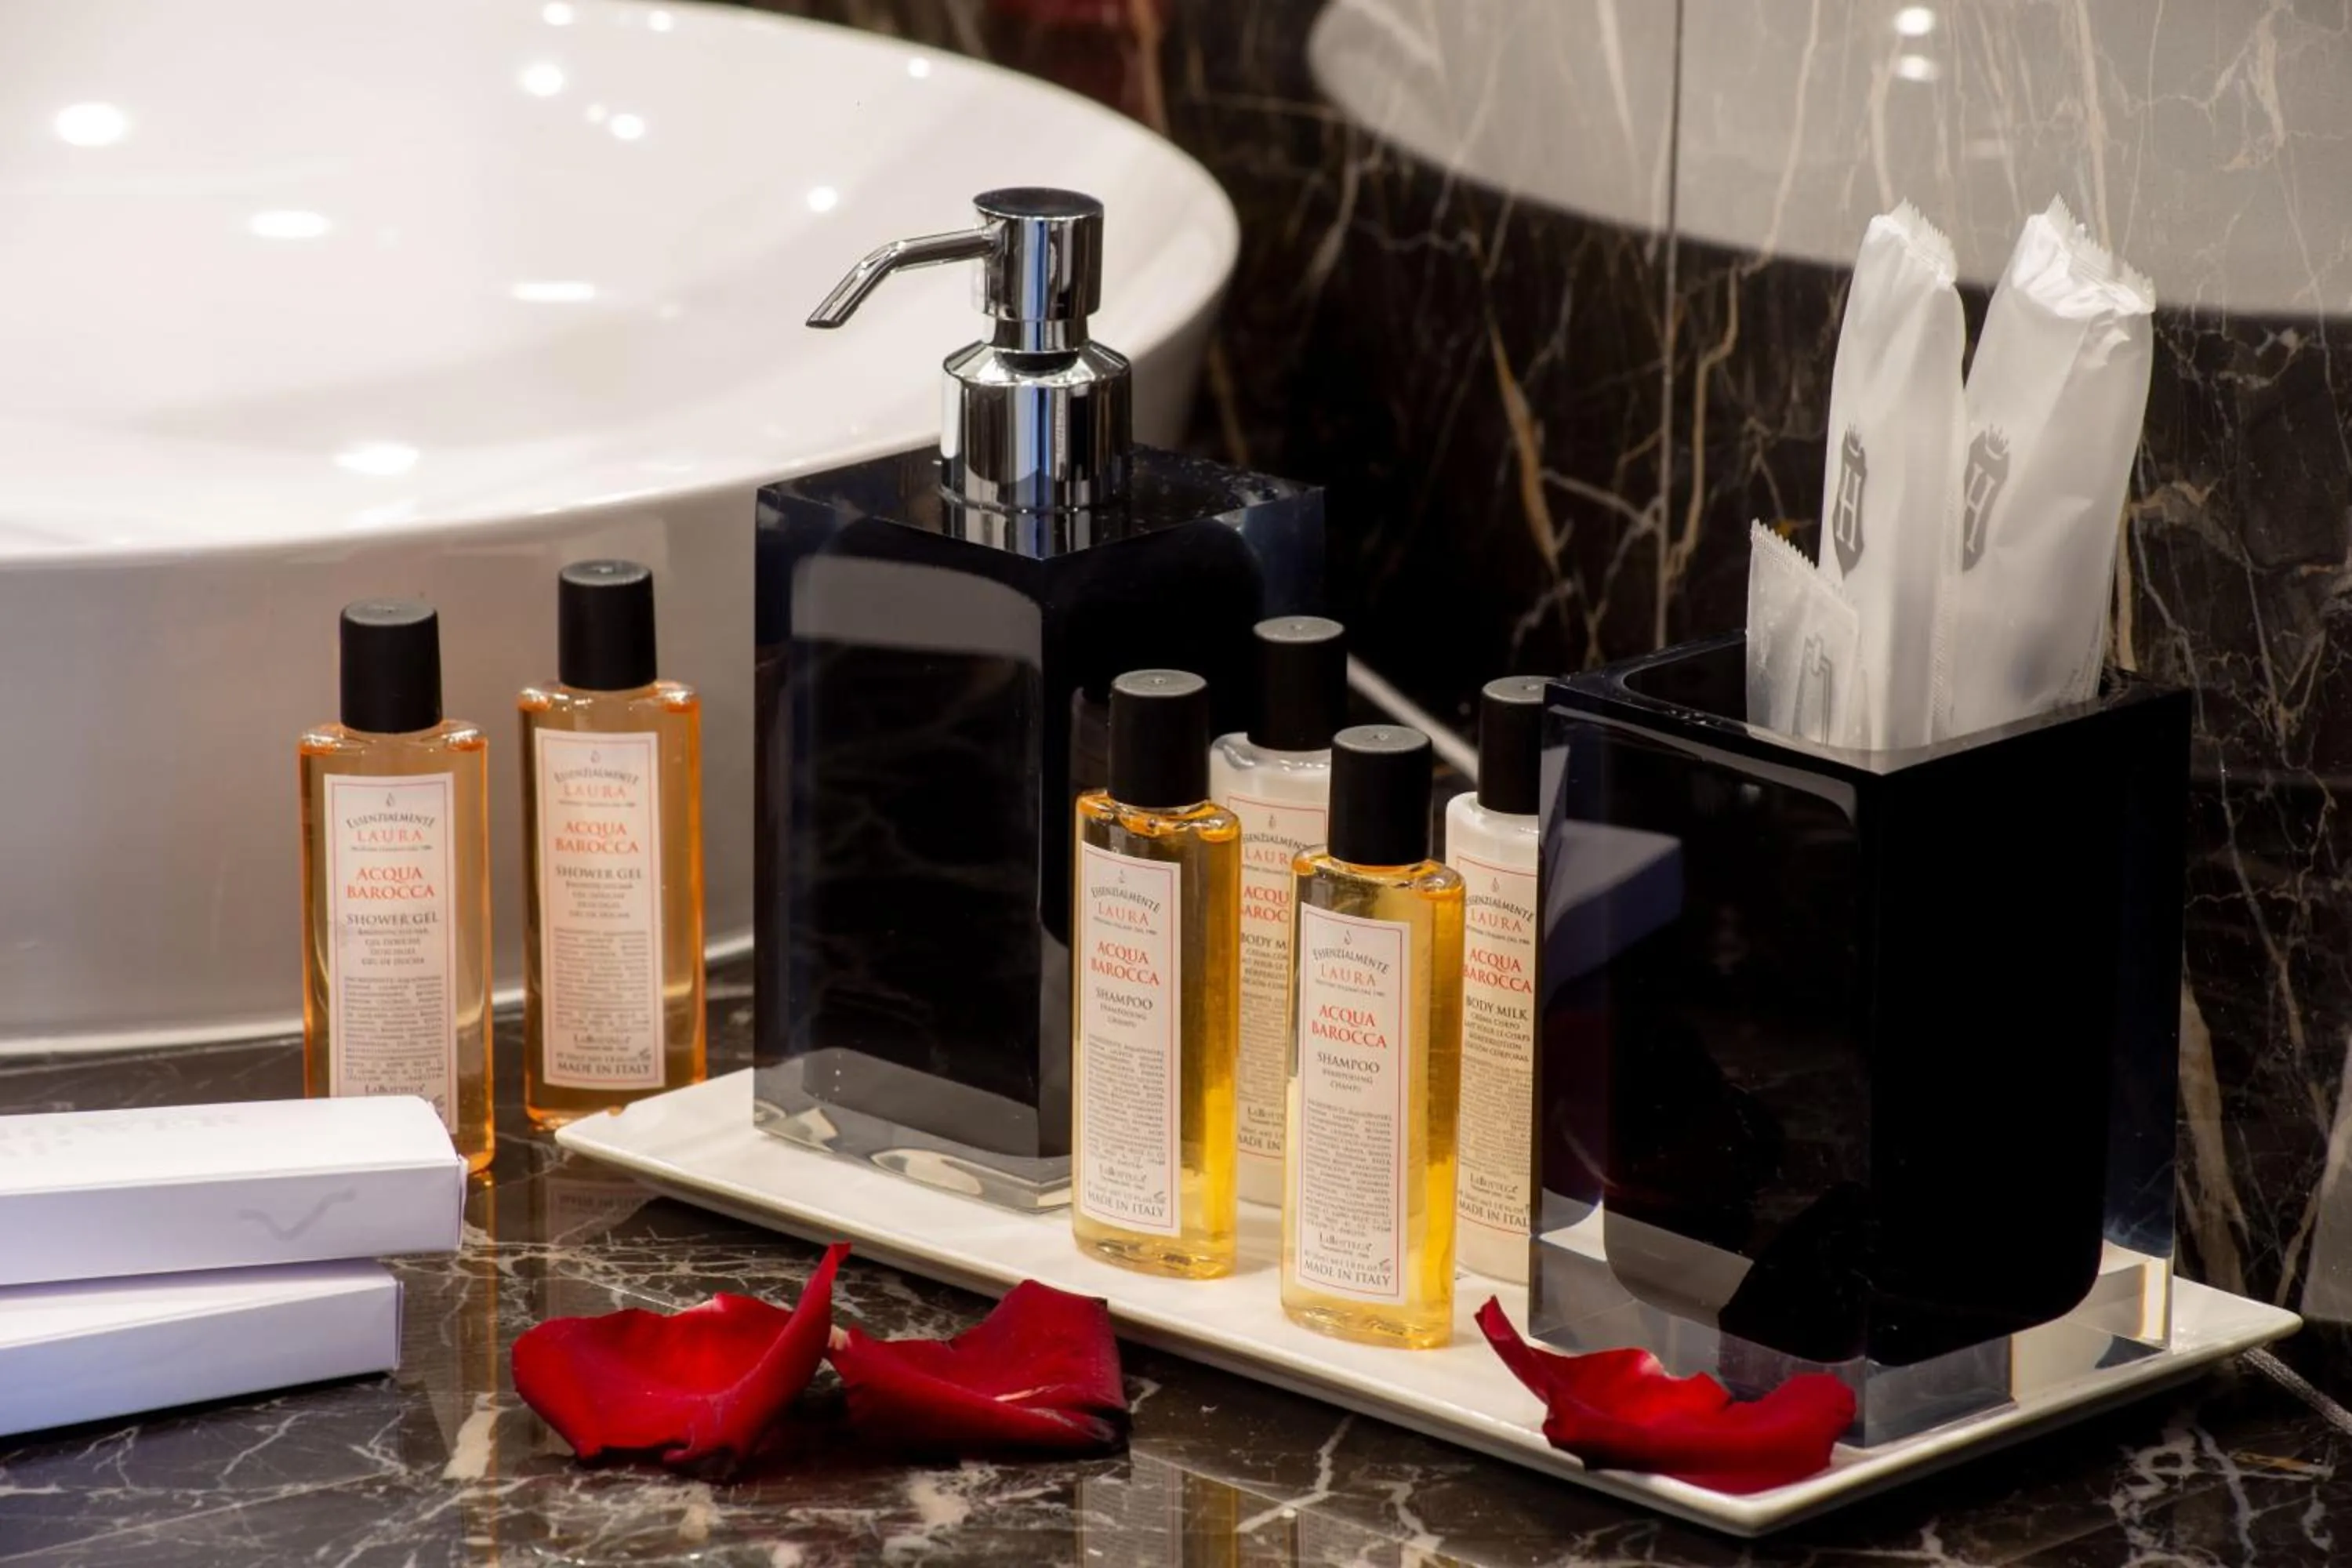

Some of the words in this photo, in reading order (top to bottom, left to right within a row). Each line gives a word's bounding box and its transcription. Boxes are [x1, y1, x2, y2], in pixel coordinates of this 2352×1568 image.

[564, 784, 626, 798] LAURA
[357, 829, 423, 843] LAURA
[565, 821, 627, 837] ACQUA
[555, 838, 639, 854] BAROCCA
[1245, 846, 1289, 865] LAUR
[356, 866, 423, 882] ACQUA
[556, 864, 612, 879] SHOWER
[616, 866, 641, 880] GEL
[347, 884, 435, 899] BAROCCA
[1244, 886, 1290, 907] ACQU
[347, 912, 408, 926] SHOWER
[412, 911, 440, 924] GEL
[1098, 902, 1149, 926] LAURA
[1241, 904, 1289, 923] AROC
[1471, 908, 1523, 933] LAURA
[1098, 942, 1149, 965] ACQUA
[1470, 949, 1522, 972] ACQUA
[1091, 958, 1160, 986] BAROCCA
[1320, 963, 1376, 987] LAURA
[1463, 964, 1532, 993] BAROCCA
[1095, 988, 1153, 1011] SHAMPOO
[1466, 996, 1494, 1013] BODY
[1497, 1005, 1529, 1021] MILK
[1319, 1004, 1375, 1027] ACQUA
[1312, 1021, 1387, 1049] BAROCCA
[557, 1062, 591, 1074] MADE
[597, 1065, 611, 1074] IN
[615, 1065, 650, 1075] ITALY
[1317, 1052, 1380, 1074] SHAMPOO
[1087, 1191, 1113, 1209] MADE
[1116, 1200, 1128, 1212] IN
[1133, 1203, 1165, 1218] ITALY
[1459, 1199, 1483, 1218] MADE
[1487, 1209, 1499, 1221] IN
[1504, 1213, 1527, 1228] ITAL
[1305, 1259, 1334, 1277] MADE
[1338, 1269, 1352, 1280] IN
[1356, 1272, 1390, 1286] ITALY
